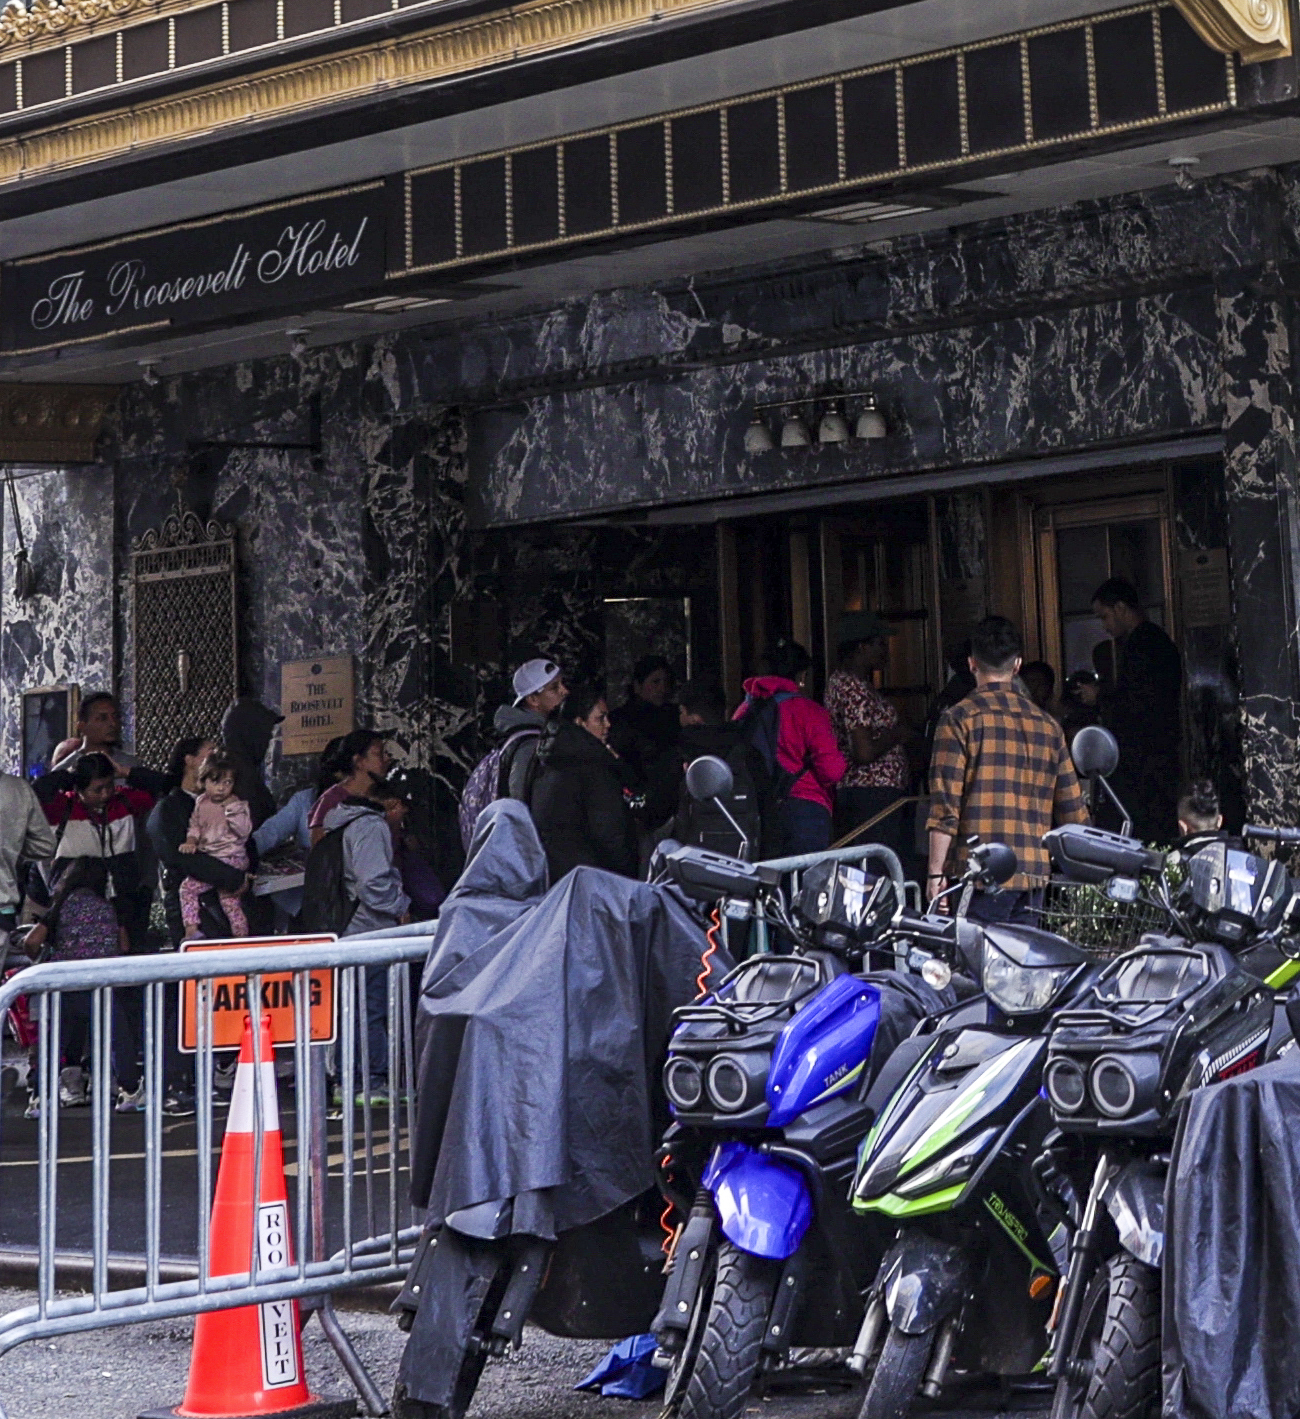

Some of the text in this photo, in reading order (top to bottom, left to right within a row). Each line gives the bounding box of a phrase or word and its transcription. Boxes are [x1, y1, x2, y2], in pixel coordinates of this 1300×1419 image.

[31, 216, 369, 330] The Roosevelt Hotel
[306, 683, 326, 696] THE
[291, 698, 344, 713] ROOSEVELT
[301, 714, 334, 728] HOTEL
[201, 978, 322, 1012] ARKING
[824, 1062, 848, 1087] TANK
